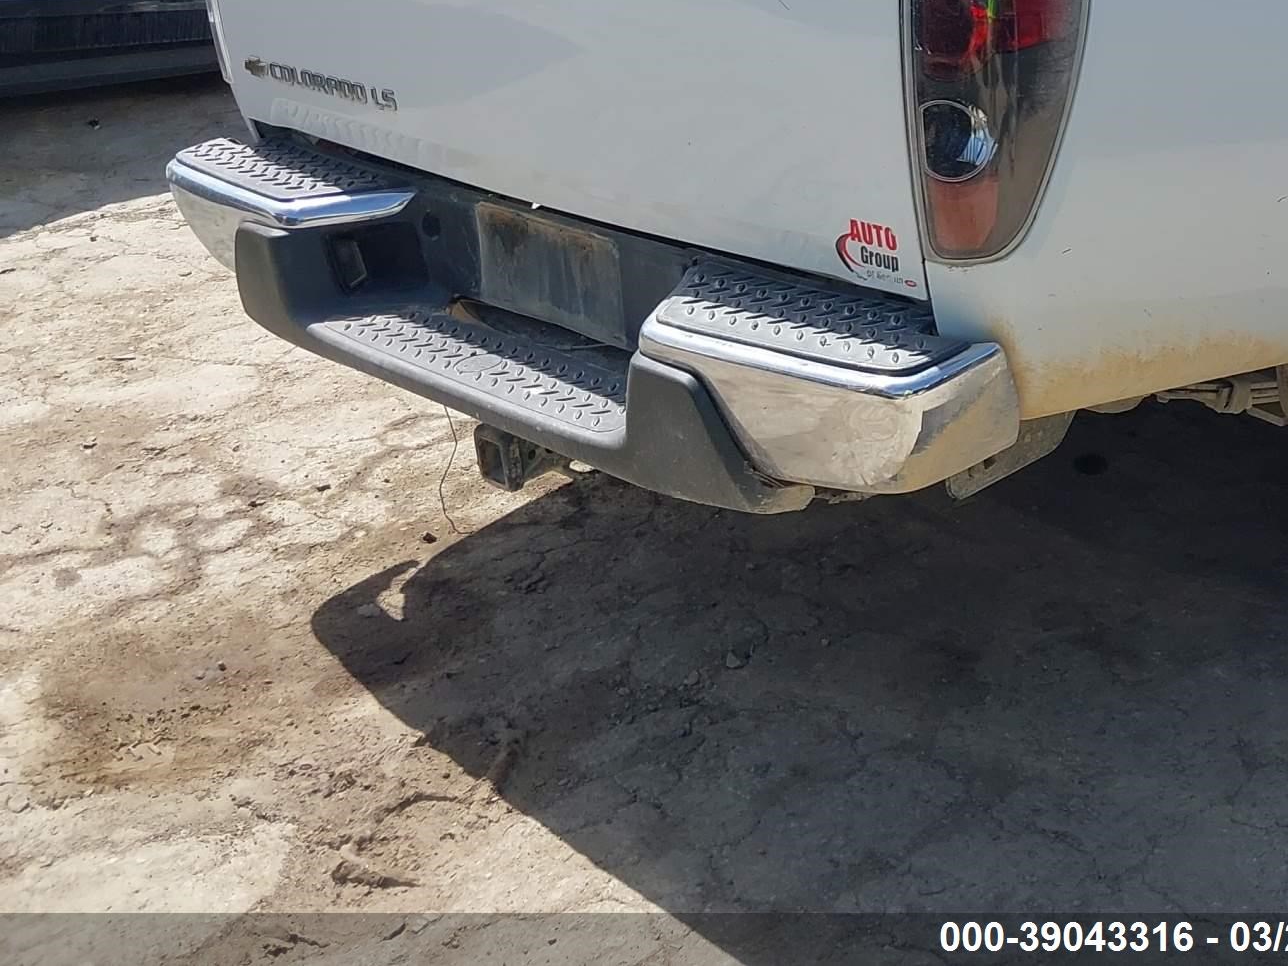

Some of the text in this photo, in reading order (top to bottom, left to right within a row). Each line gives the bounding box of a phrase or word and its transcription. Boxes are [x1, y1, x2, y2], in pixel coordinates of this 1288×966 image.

[270, 62, 398, 111] COLORADO LS
[849, 218, 898, 251] AUTO
[860, 246, 899, 272] Group
